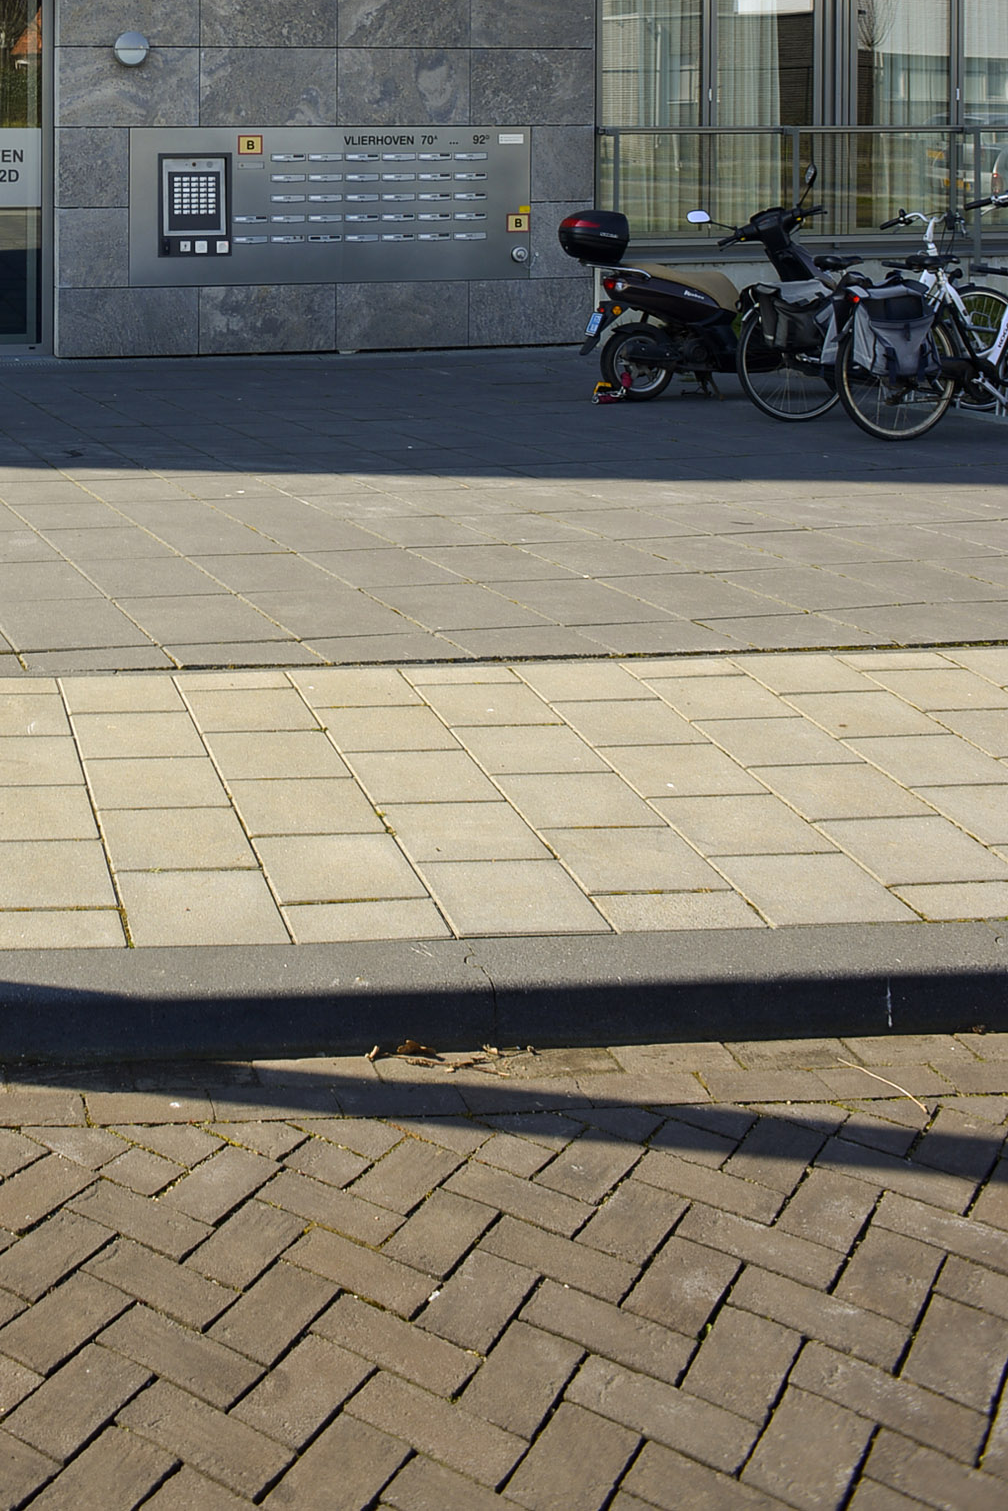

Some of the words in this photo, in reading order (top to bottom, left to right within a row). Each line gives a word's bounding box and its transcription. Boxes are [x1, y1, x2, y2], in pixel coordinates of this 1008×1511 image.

[246, 140, 255, 150] B
[344, 135, 415, 146] VLIERHOVEN
[514, 218, 523, 228] B
